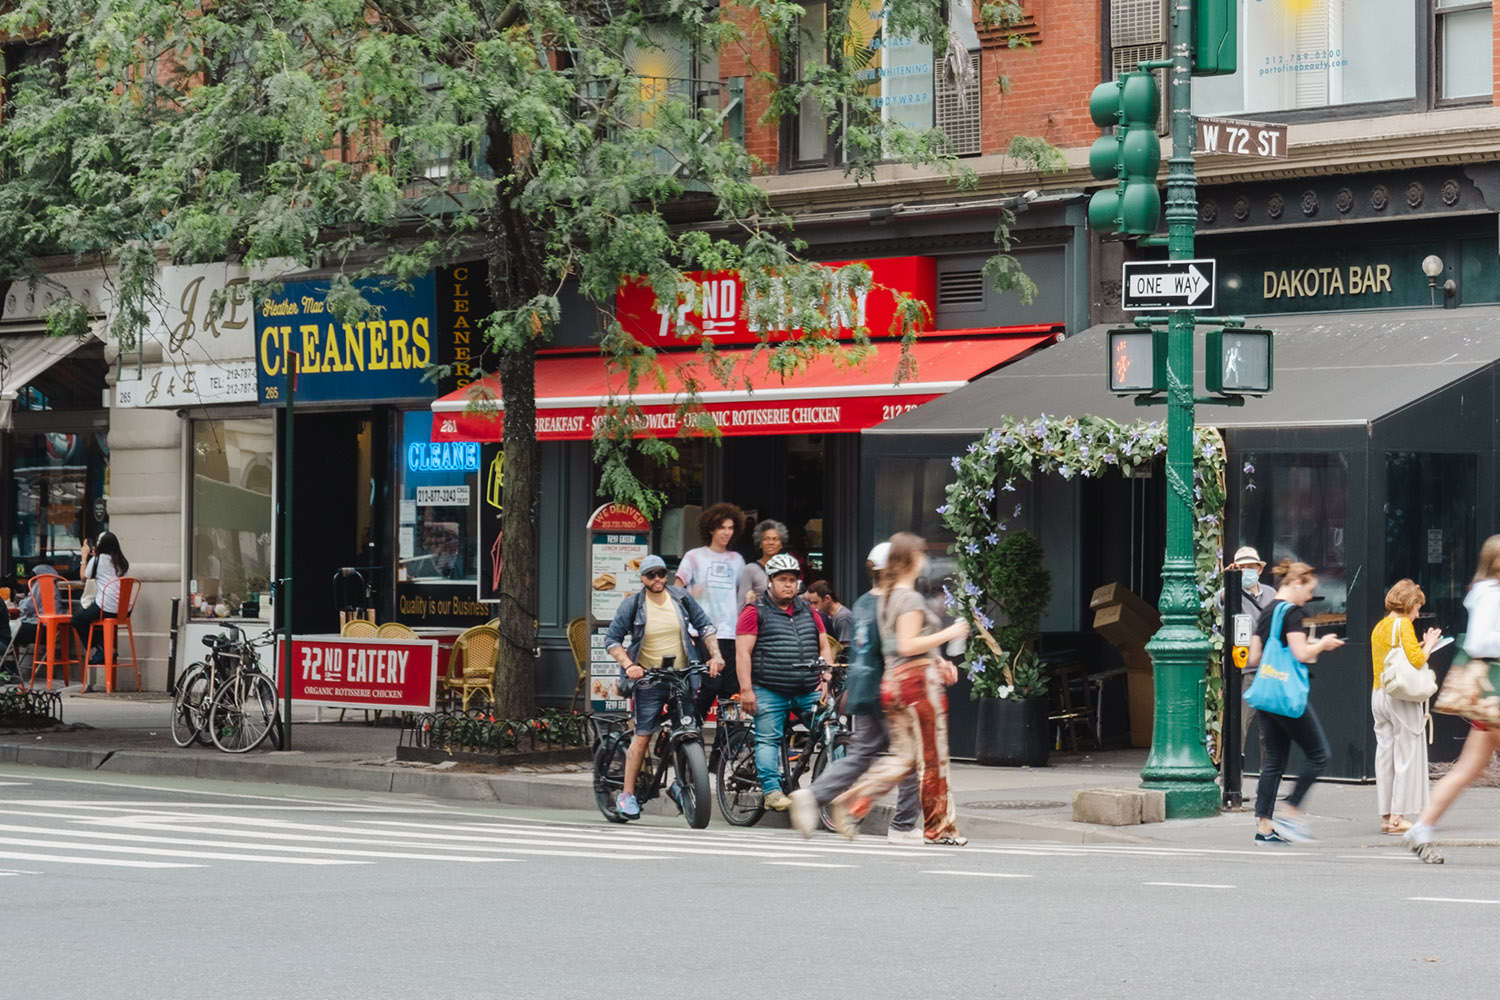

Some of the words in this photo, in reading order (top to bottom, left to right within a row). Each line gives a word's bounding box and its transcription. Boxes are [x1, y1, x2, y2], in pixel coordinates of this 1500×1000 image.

[1258, 59, 1349, 77] portofinobeauty.com
[1203, 125, 1219, 153] W
[1226, 127, 1250, 155] 72
[1257, 130, 1280, 157] ST
[1137, 277, 1162, 294] ONE
[1174, 276, 1201, 294] WAY
[1263, 267, 1345, 299] DAKOTA
[1349, 264, 1392, 294] BAR
[262, 298, 299, 318] Heather
[301, 296, 324, 314] Mac
[260, 316, 431, 377] CLEANERS
[120, 392, 132, 404] 265
[265, 386, 279, 400] 265
[440, 419, 458, 433] 261
[535, 416, 585, 433] BREAKFAST
[732, 408, 790, 427] ROTISSERIE
[792, 406, 841, 424] CHICKEN
[595, 506, 610, 524] WE
[610, 503, 645, 526] DELIVER
[400, 595, 428, 619] Quality
[429, 595, 437, 616] is
[437, 600, 451, 615] our
[452, 596, 489, 616] Business
[347, 648, 410, 684] EATERY
[303, 686, 334, 696] ORGANIC
[334, 687, 371, 698] ROTISSERIE
[371, 689, 404, 699] CHICKEN
